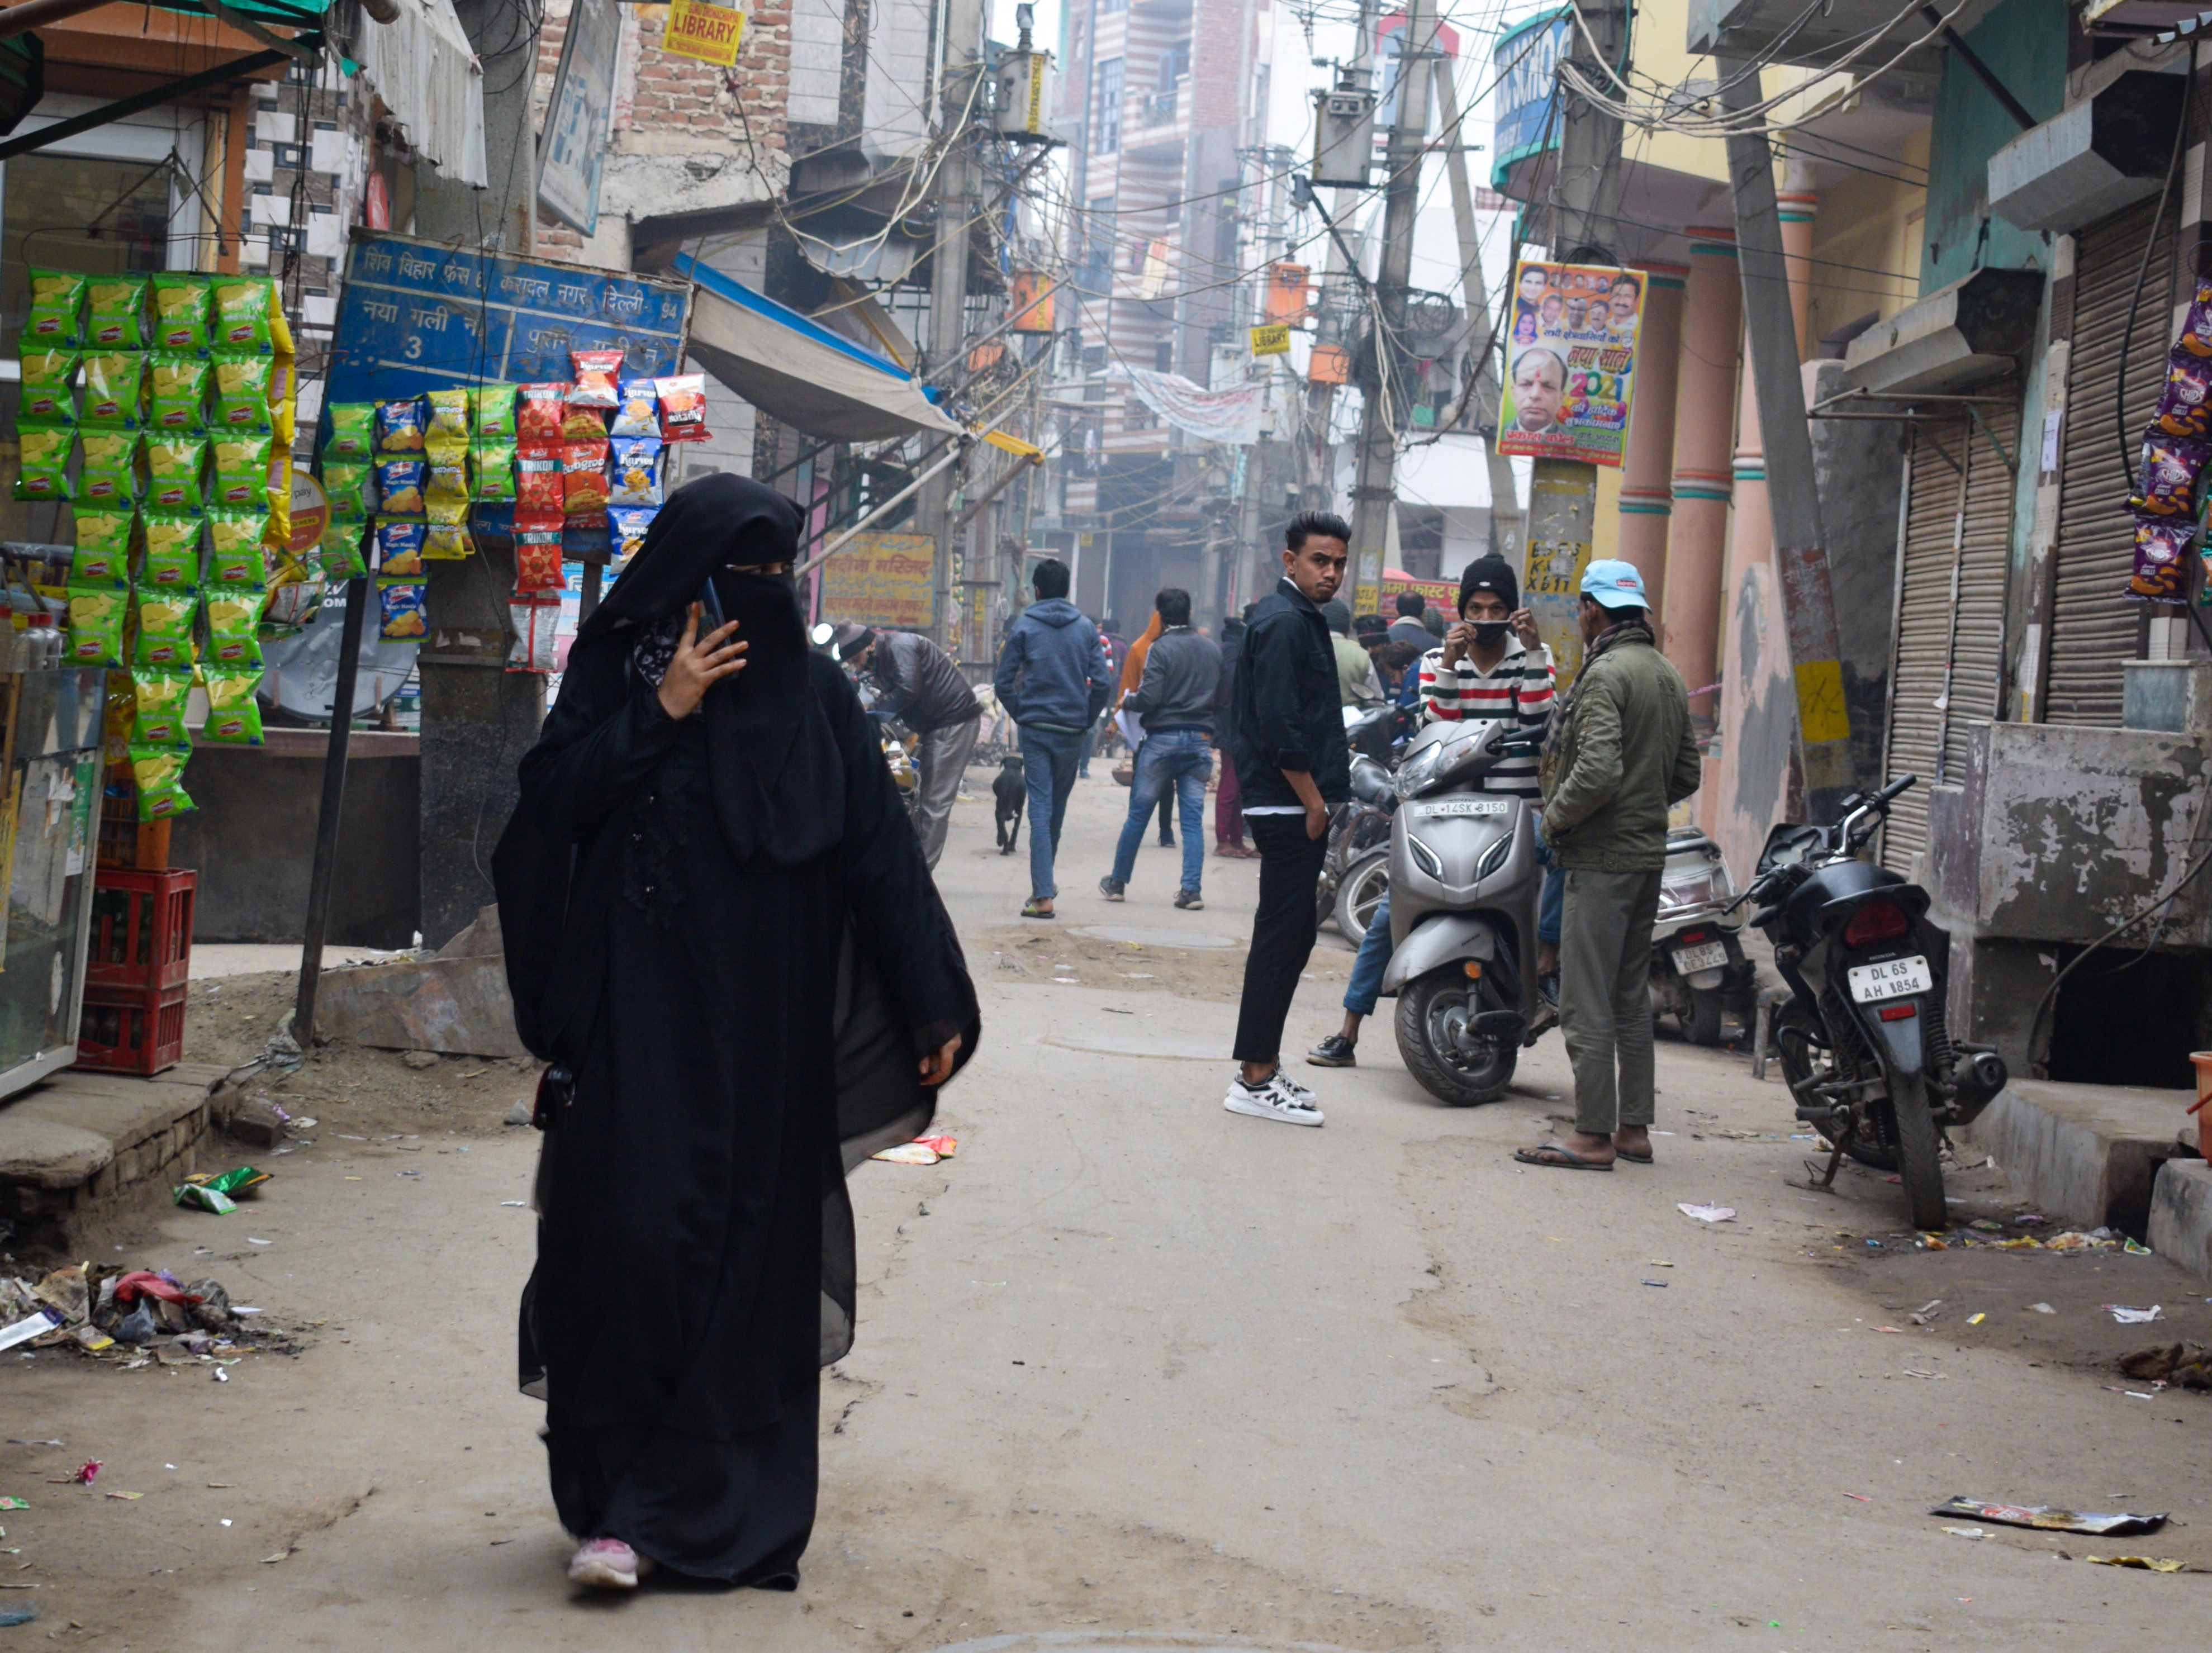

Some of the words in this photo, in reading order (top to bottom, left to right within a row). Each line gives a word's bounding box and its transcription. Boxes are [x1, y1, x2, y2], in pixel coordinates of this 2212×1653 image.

[673, 12, 736, 43] LIBRARY
[398, 251, 436, 280] विहार
[661, 302, 677, 319] 94
[363, 301, 398, 323] नया
[411, 306, 449, 331] गली
[405, 336, 422, 359] 3
[1568, 345, 1599, 369] नया
[1599, 349, 1631, 373] साल
[523, 390, 555, 400] TRIKON
[1569, 371, 1624, 401] 2021
[520, 460, 554, 471] TRIKON
[523, 533, 553, 543] TRIKON
[618, 522, 648, 536] Kurve
[1426, 805, 1439, 814] DL
[1871, 967, 1888, 980] DL
[1892, 962, 1907, 976] 6S
[1864, 985, 1883, 999] AH
